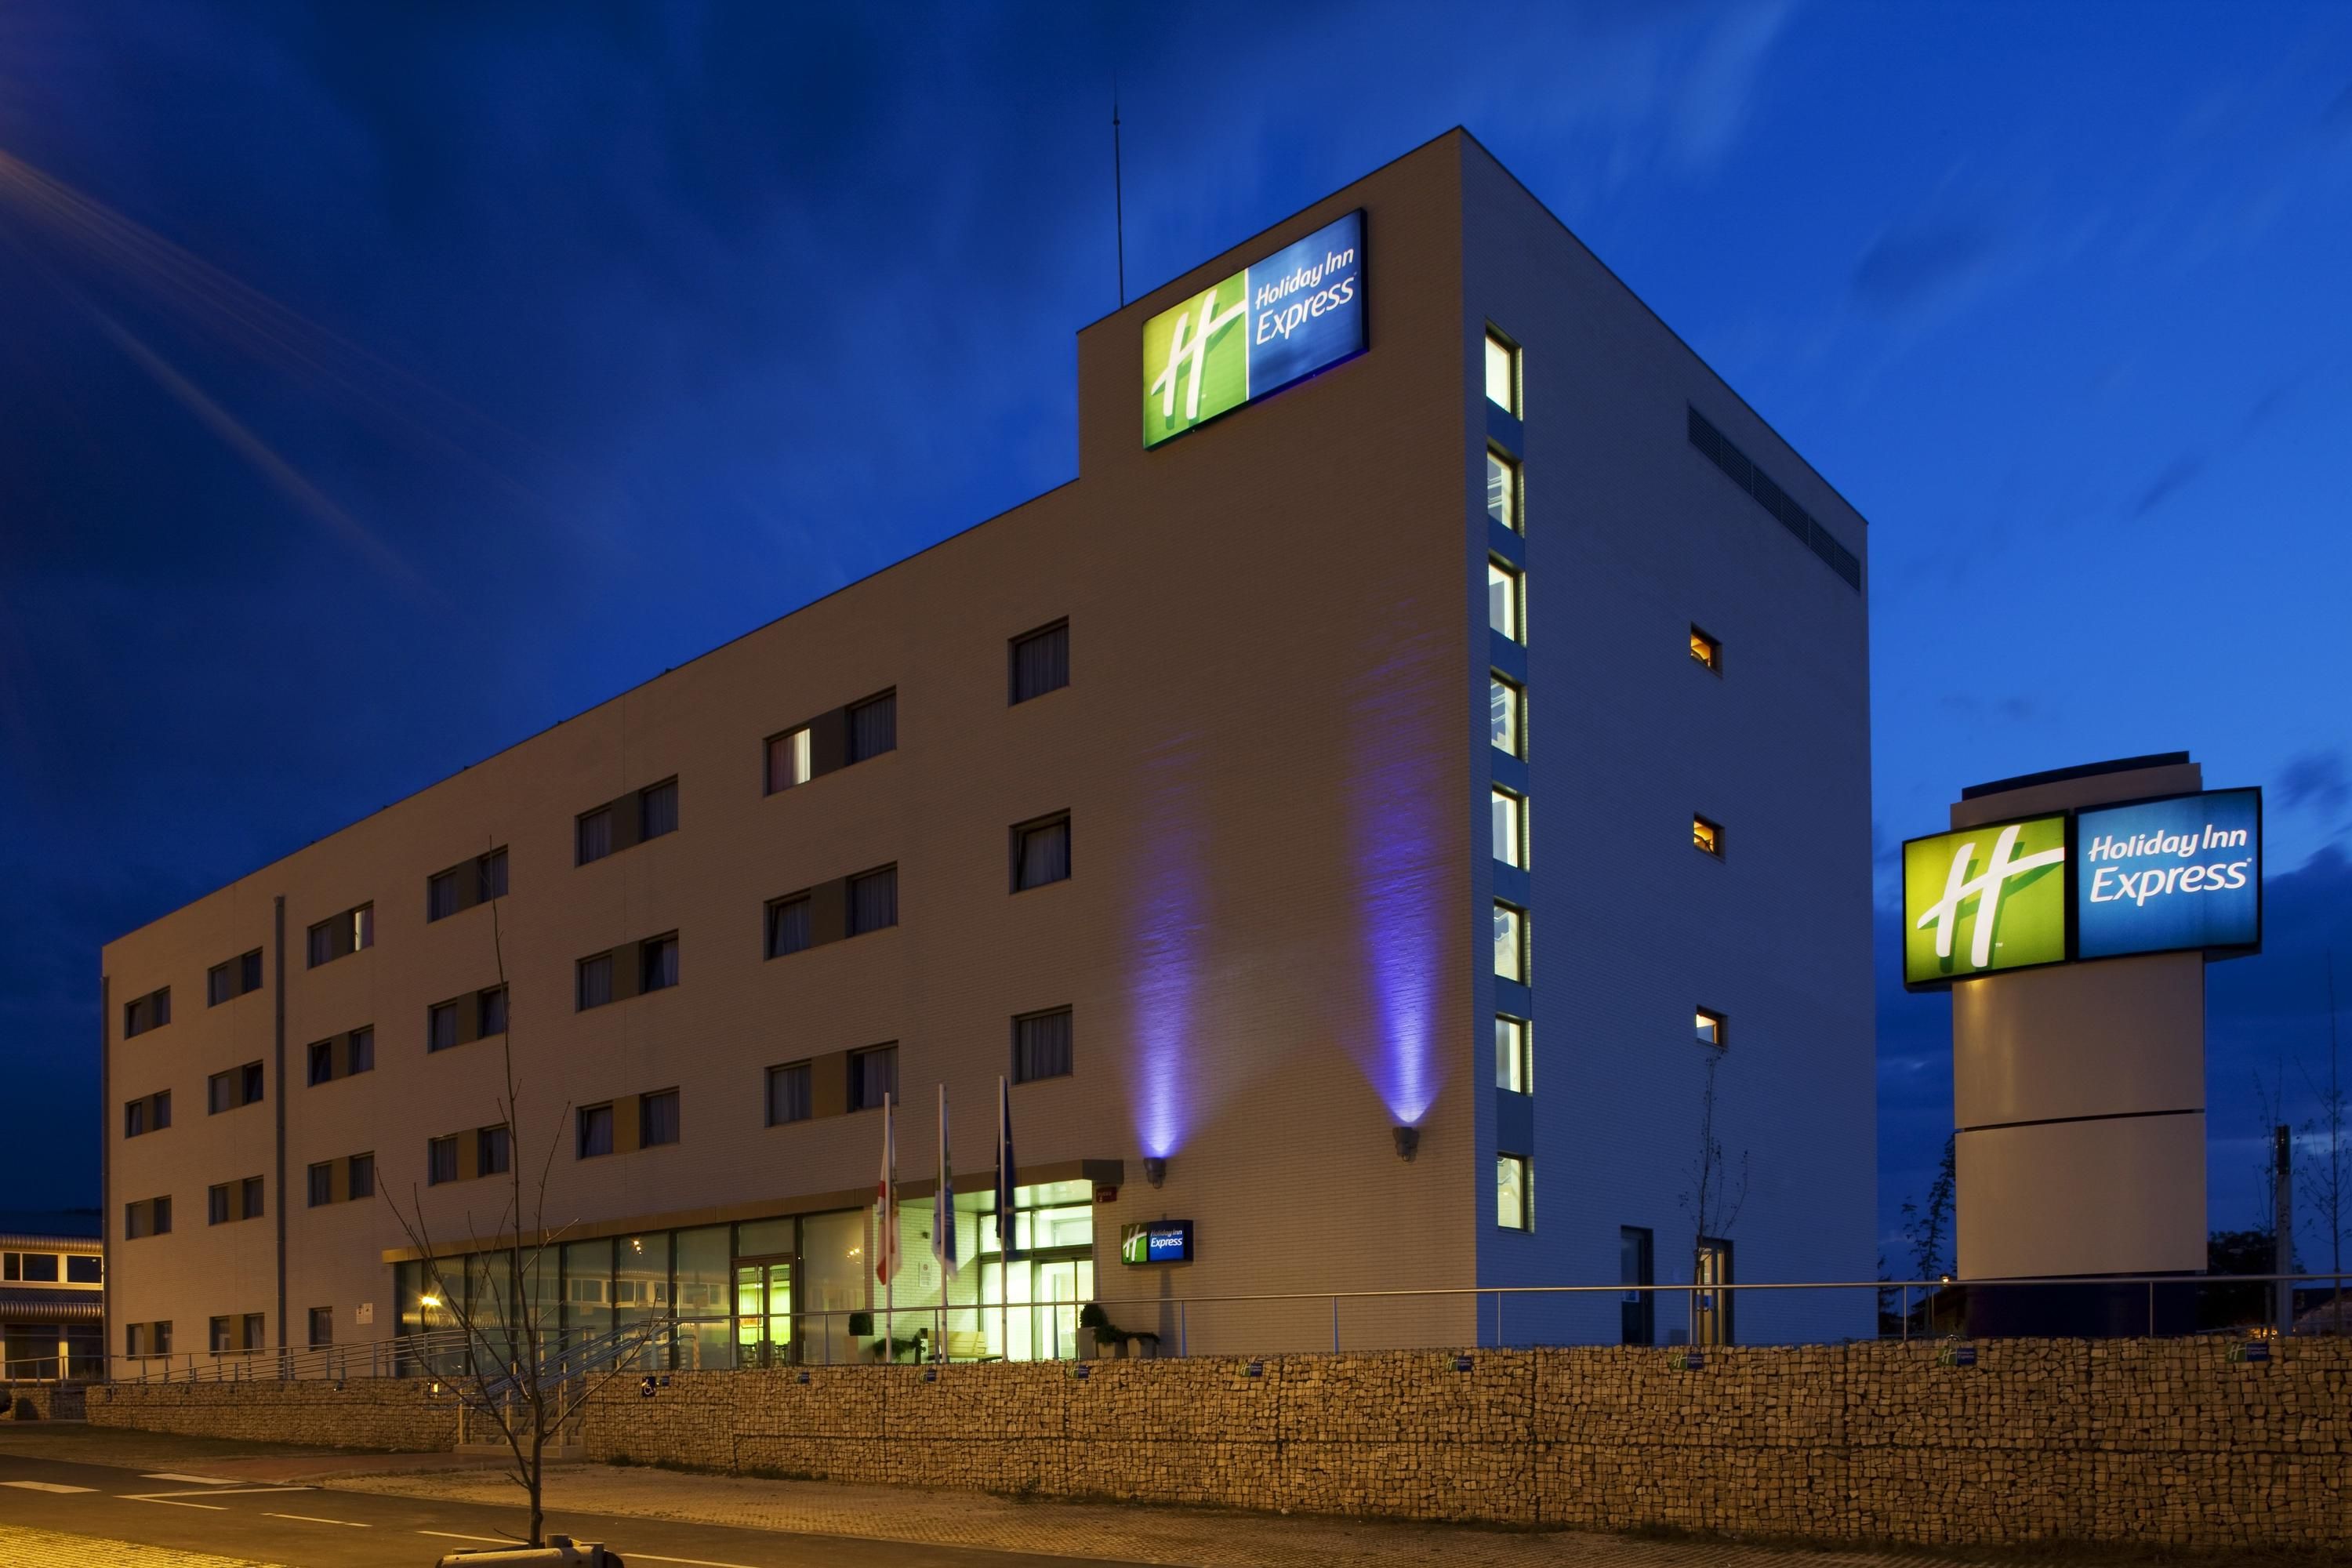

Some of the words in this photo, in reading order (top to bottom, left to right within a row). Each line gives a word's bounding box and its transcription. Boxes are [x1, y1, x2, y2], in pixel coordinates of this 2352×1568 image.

[1254, 263, 1323, 310] Holiday
[1325, 248, 1355, 276] Inn
[1256, 276, 1356, 346] Express
[2088, 829, 2197, 862] Holiday
[2202, 824, 2247, 849] Inn
[2089, 861, 2249, 907] Express
[1150, 1237, 1183, 1249] Express
